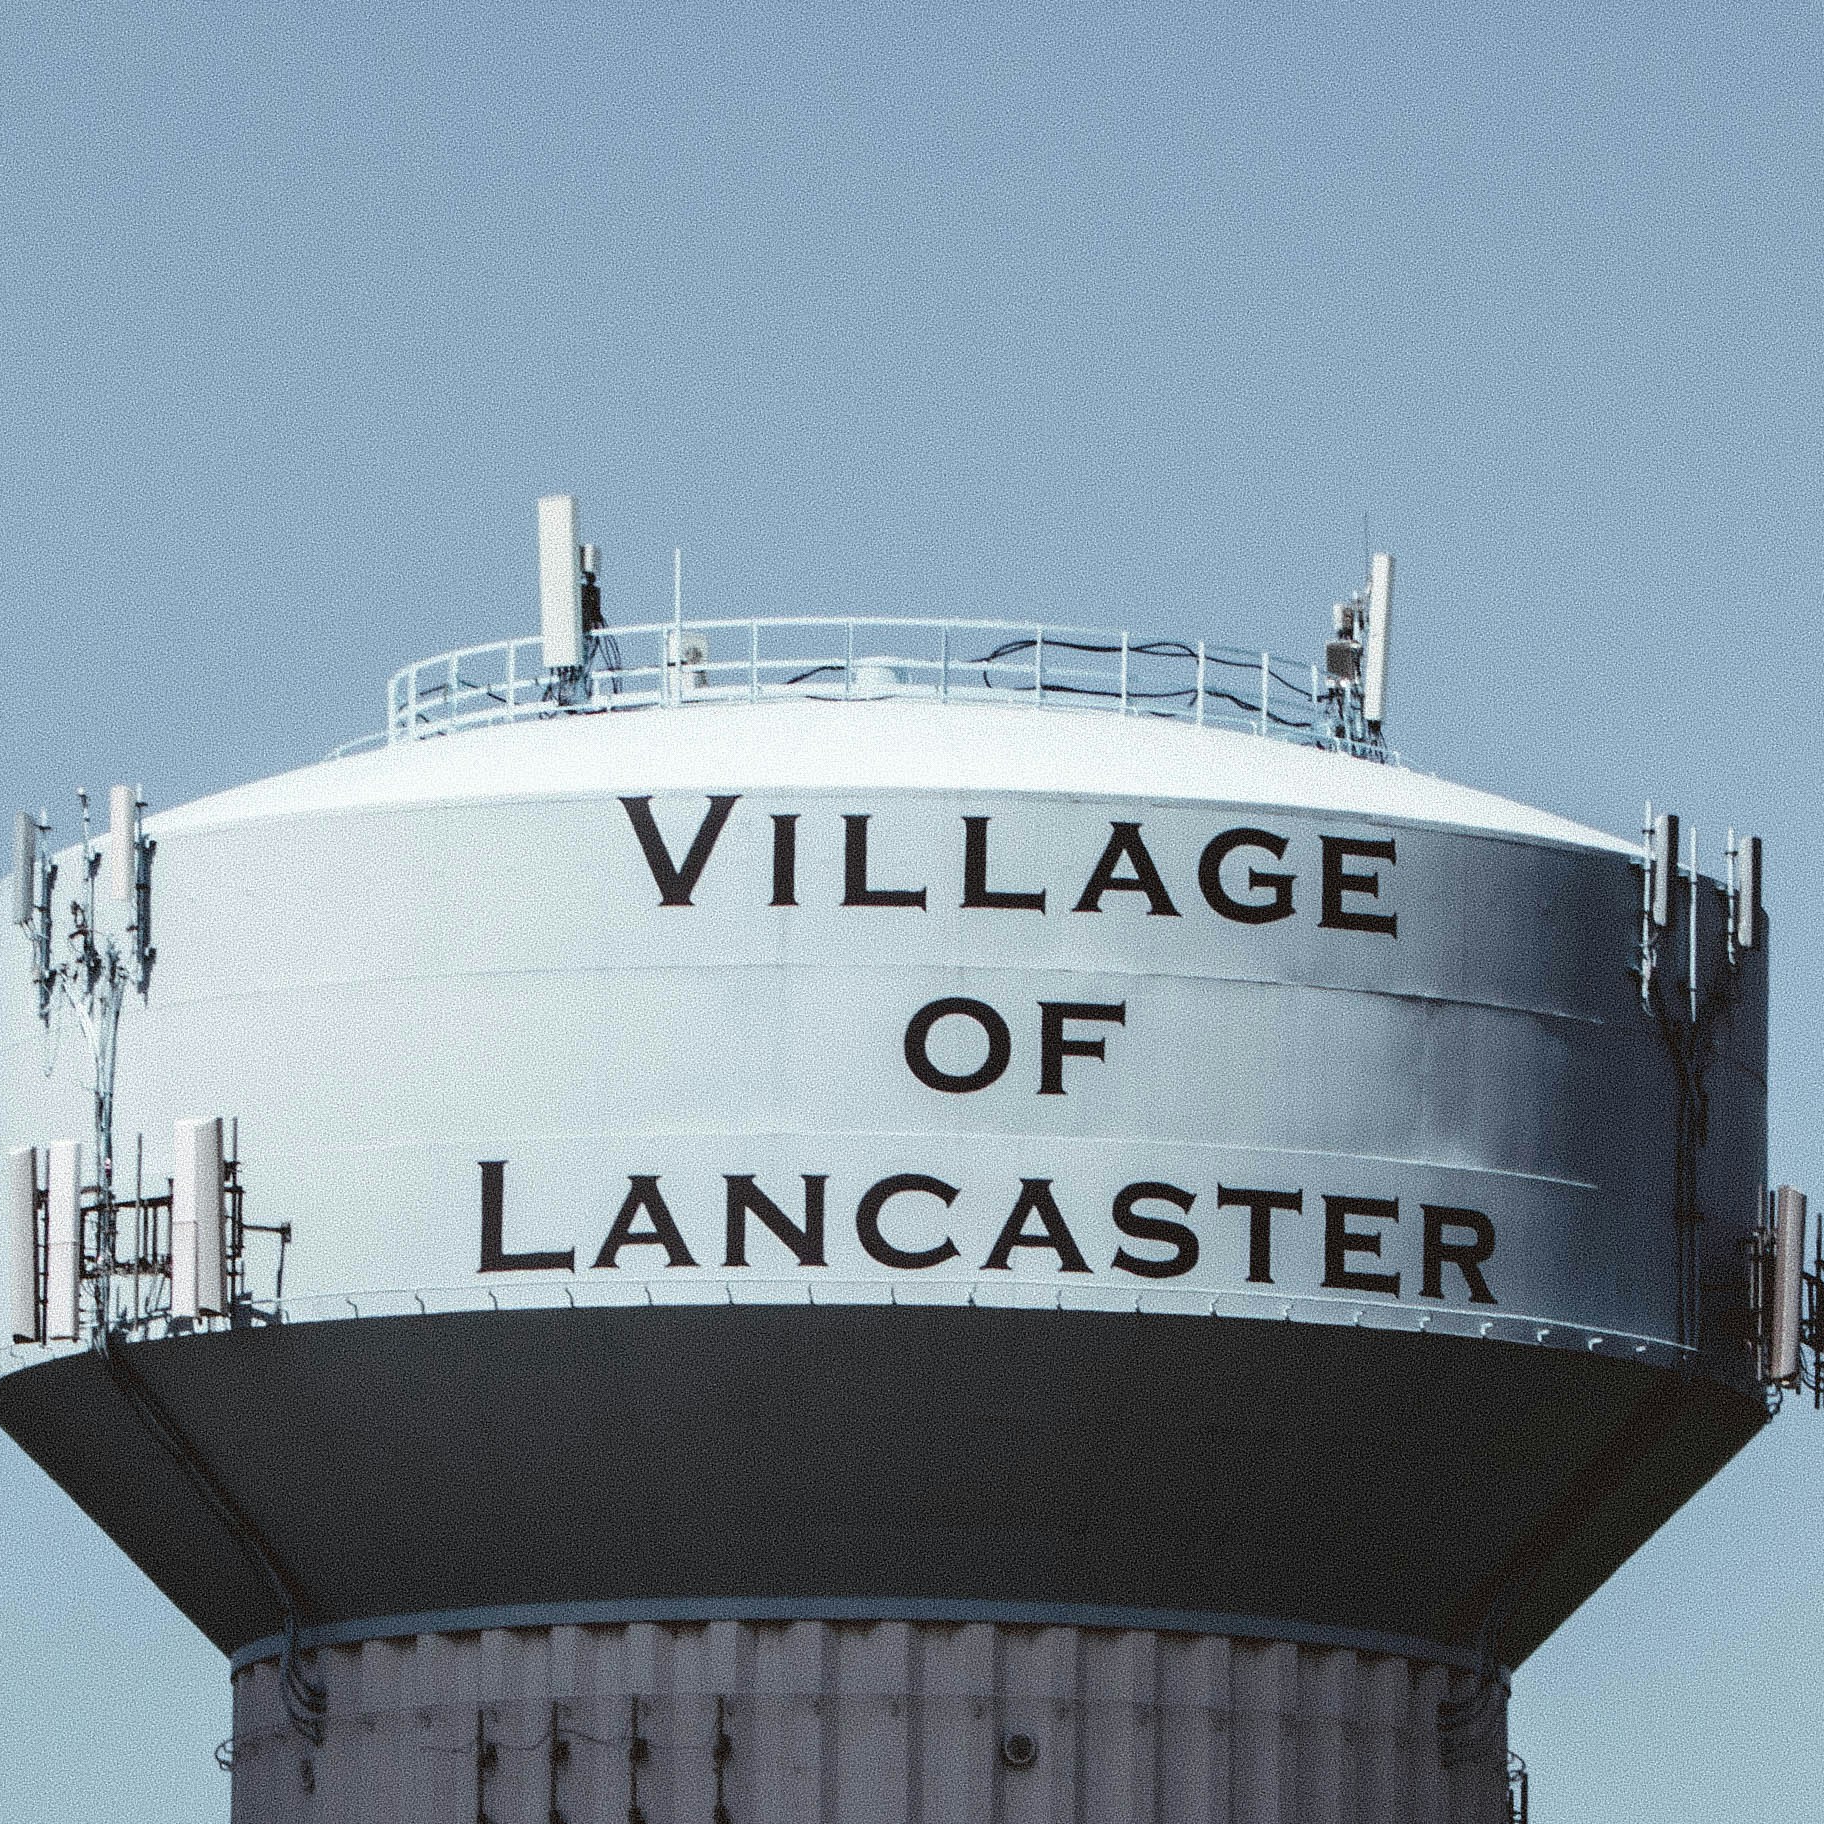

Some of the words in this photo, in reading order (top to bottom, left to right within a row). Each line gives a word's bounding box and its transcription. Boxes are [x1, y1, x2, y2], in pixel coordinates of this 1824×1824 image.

[618, 795, 1399, 939] VILLAGE
[903, 997, 1127, 1095] OF
[478, 1160, 1500, 1306] LANCASTER
